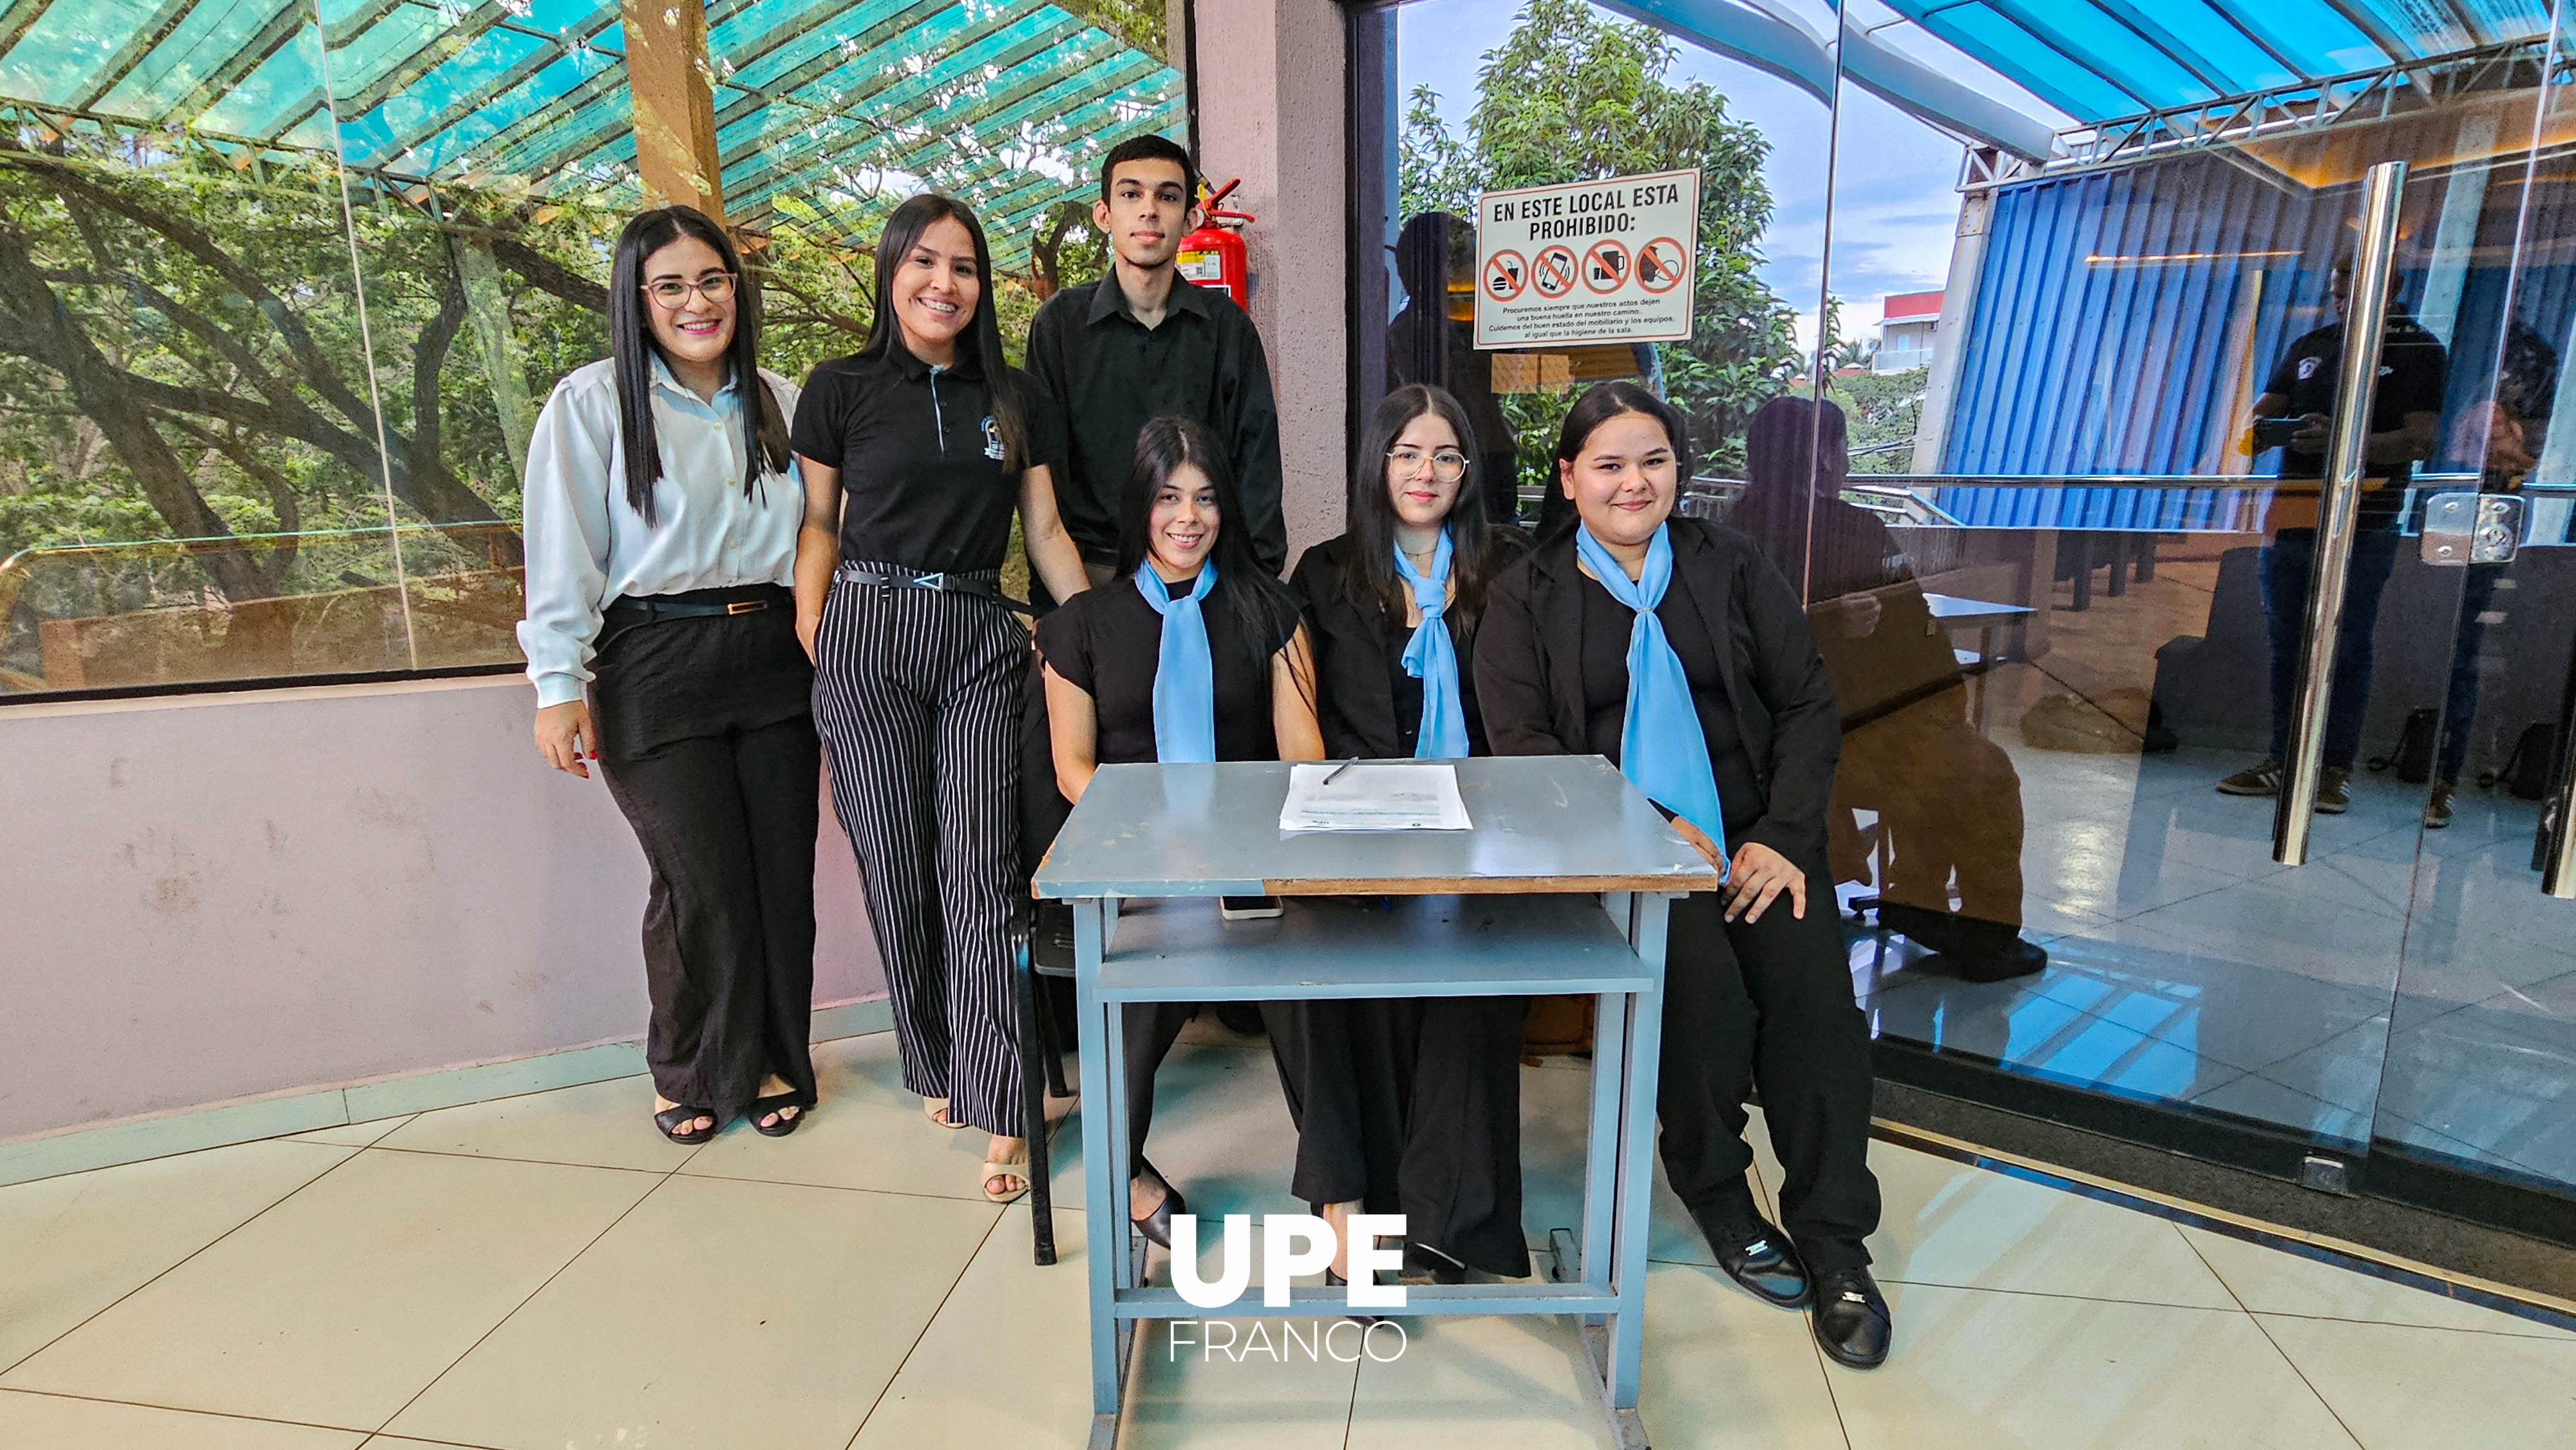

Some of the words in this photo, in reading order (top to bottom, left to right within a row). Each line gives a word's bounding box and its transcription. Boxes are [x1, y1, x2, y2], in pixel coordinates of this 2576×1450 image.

[1494, 202, 1514, 222] EN
[1521, 197, 1562, 219] ESTE
[1569, 190, 1625, 214] LOCAL
[1633, 184, 1678, 207] ESTA
[1530, 213, 1635, 241] PROHIBIDO:
